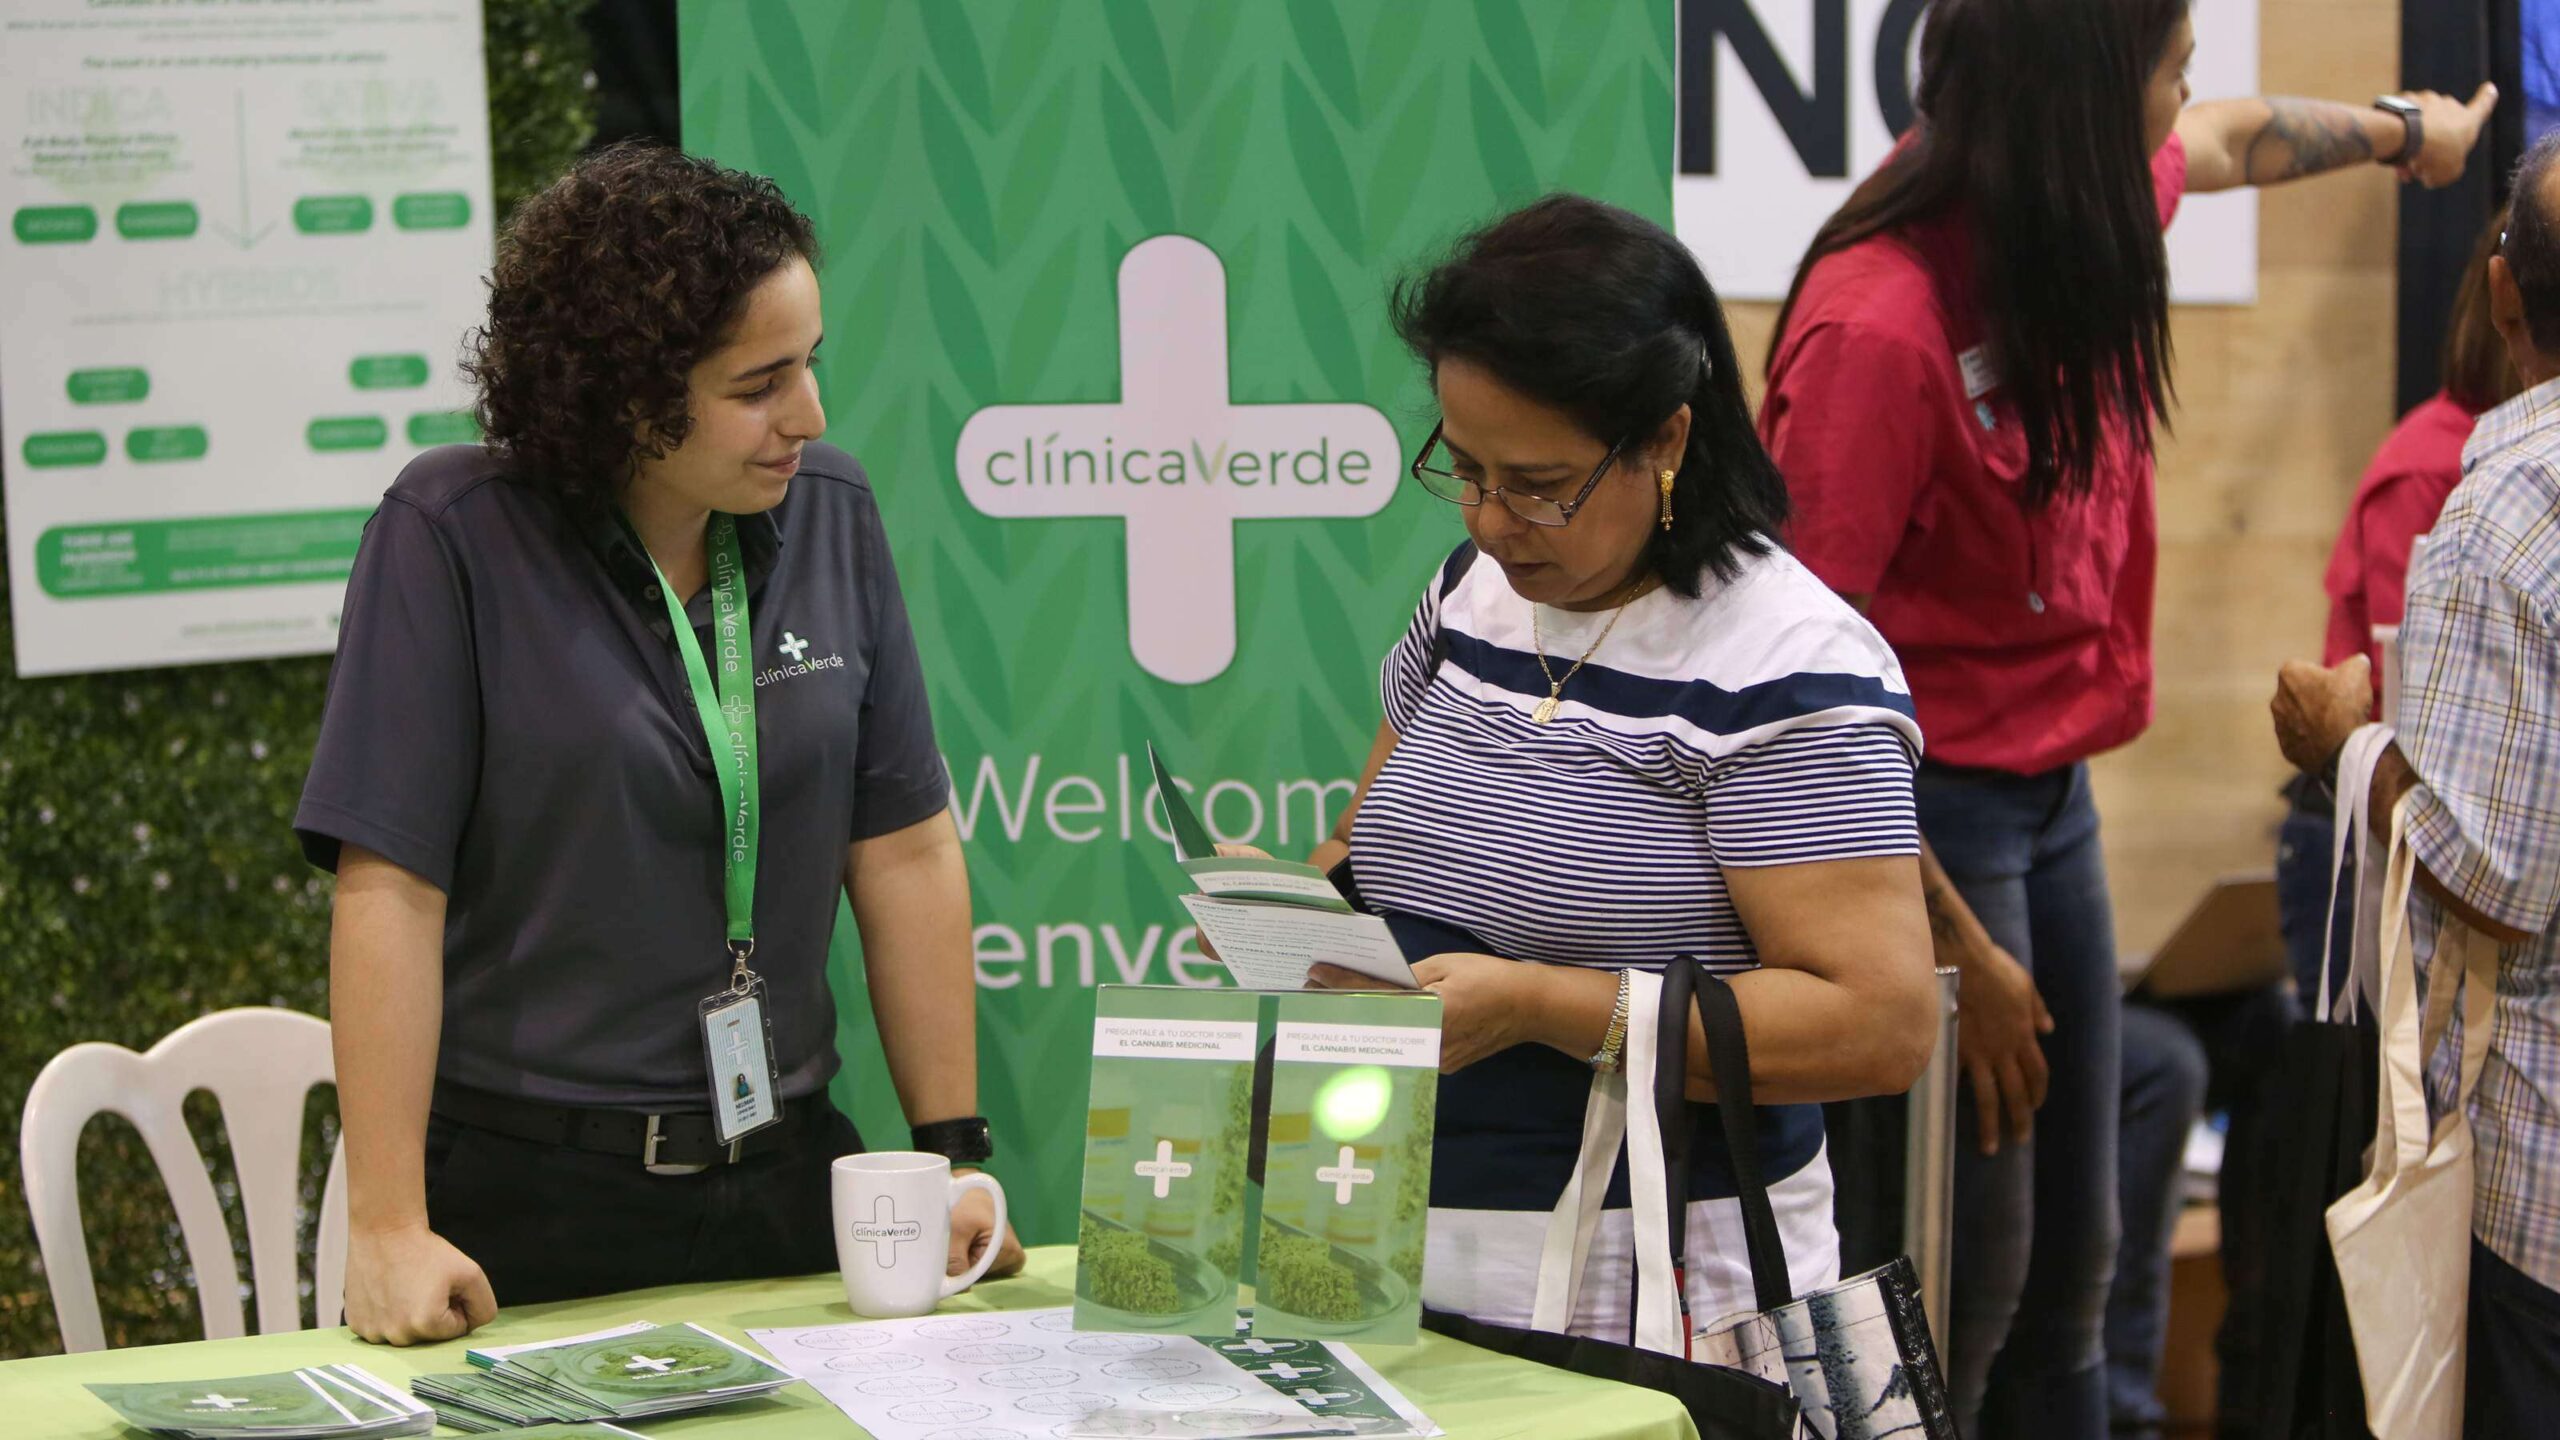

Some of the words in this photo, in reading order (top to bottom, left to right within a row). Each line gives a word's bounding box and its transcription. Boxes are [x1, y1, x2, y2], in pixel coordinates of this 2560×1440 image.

[986, 432, 1372, 486] clínicaVerde
[755, 653, 844, 688] clínicaVerde
[1179, 1030, 1217, 1039] DOCTOR
[1362, 1035, 1399, 1044] DOCTOR
[1119, 1039, 1129, 1047] EL
[1131, 1039, 1174, 1049] CANNABIS
[1175, 1040, 1222, 1050] MEDICINAL
[1300, 1044, 1311, 1052] EL
[1312, 1045, 1357, 1054] CANNABIS
[1358, 1046, 1404, 1056] MEDICINAL
[855, 1226, 917, 1237] clínicaVerde
